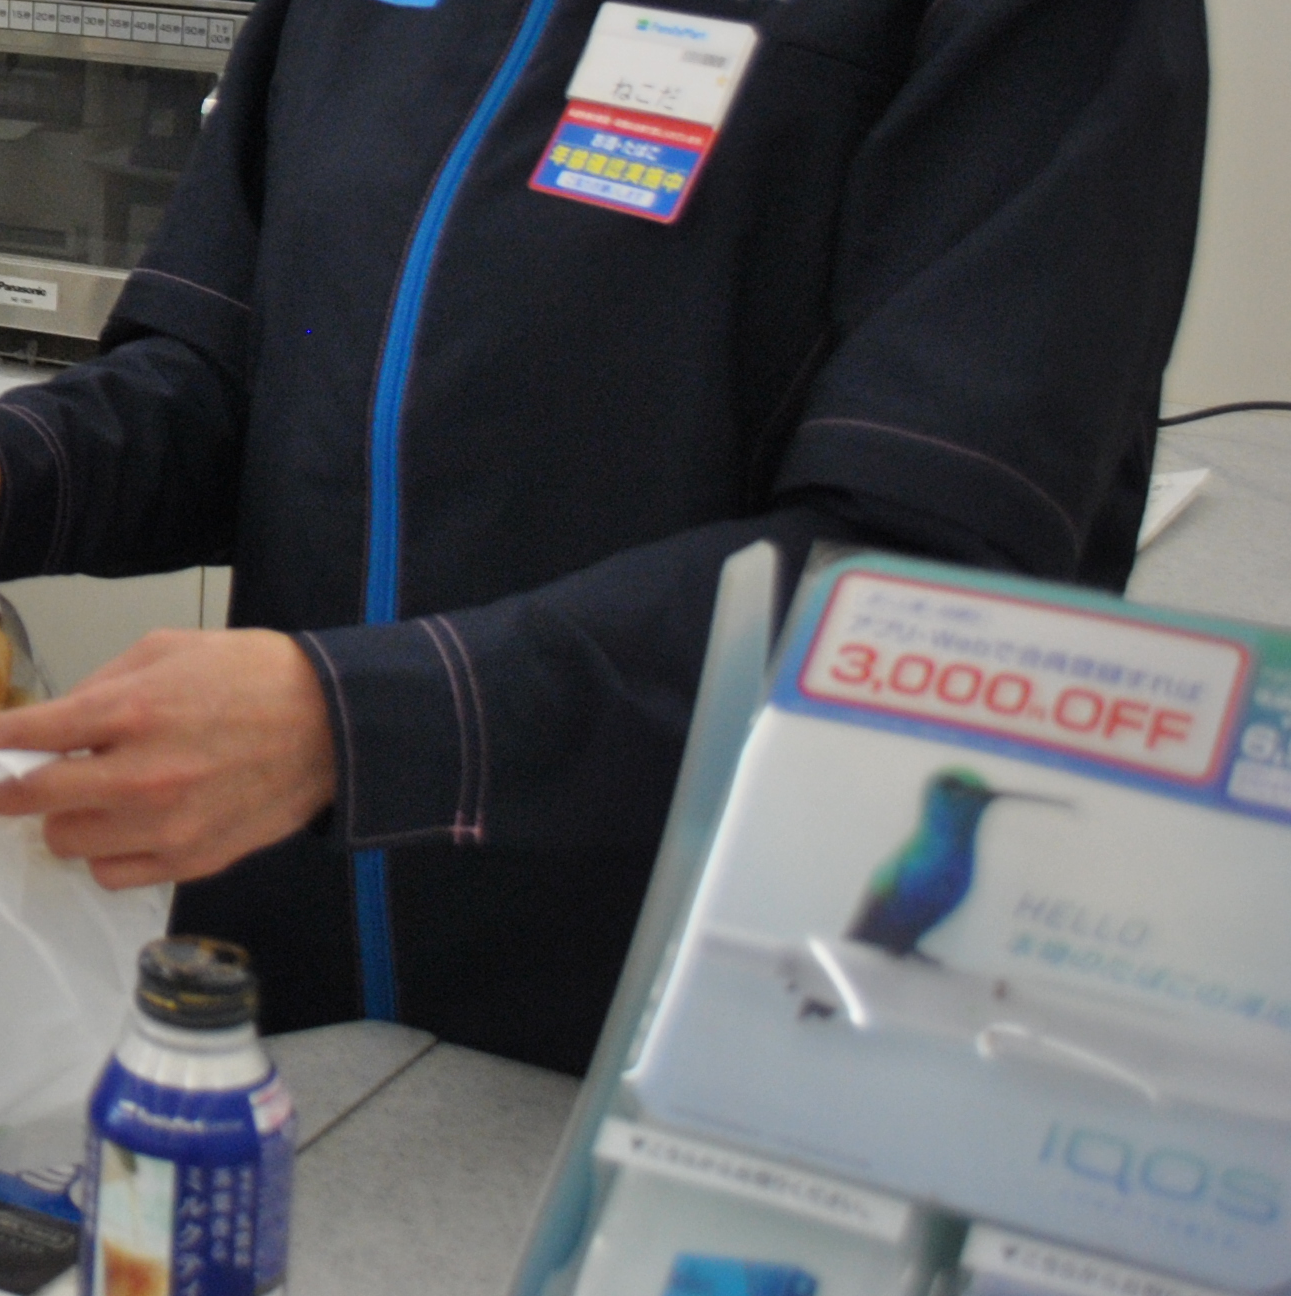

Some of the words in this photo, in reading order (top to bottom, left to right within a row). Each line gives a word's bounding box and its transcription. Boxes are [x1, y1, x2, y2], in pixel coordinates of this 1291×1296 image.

[612, 80, 682, 112] ねこだ
[1017, 896, 1151, 947] HELLO
[1038, 1120, 1283, 1226] IQOS
